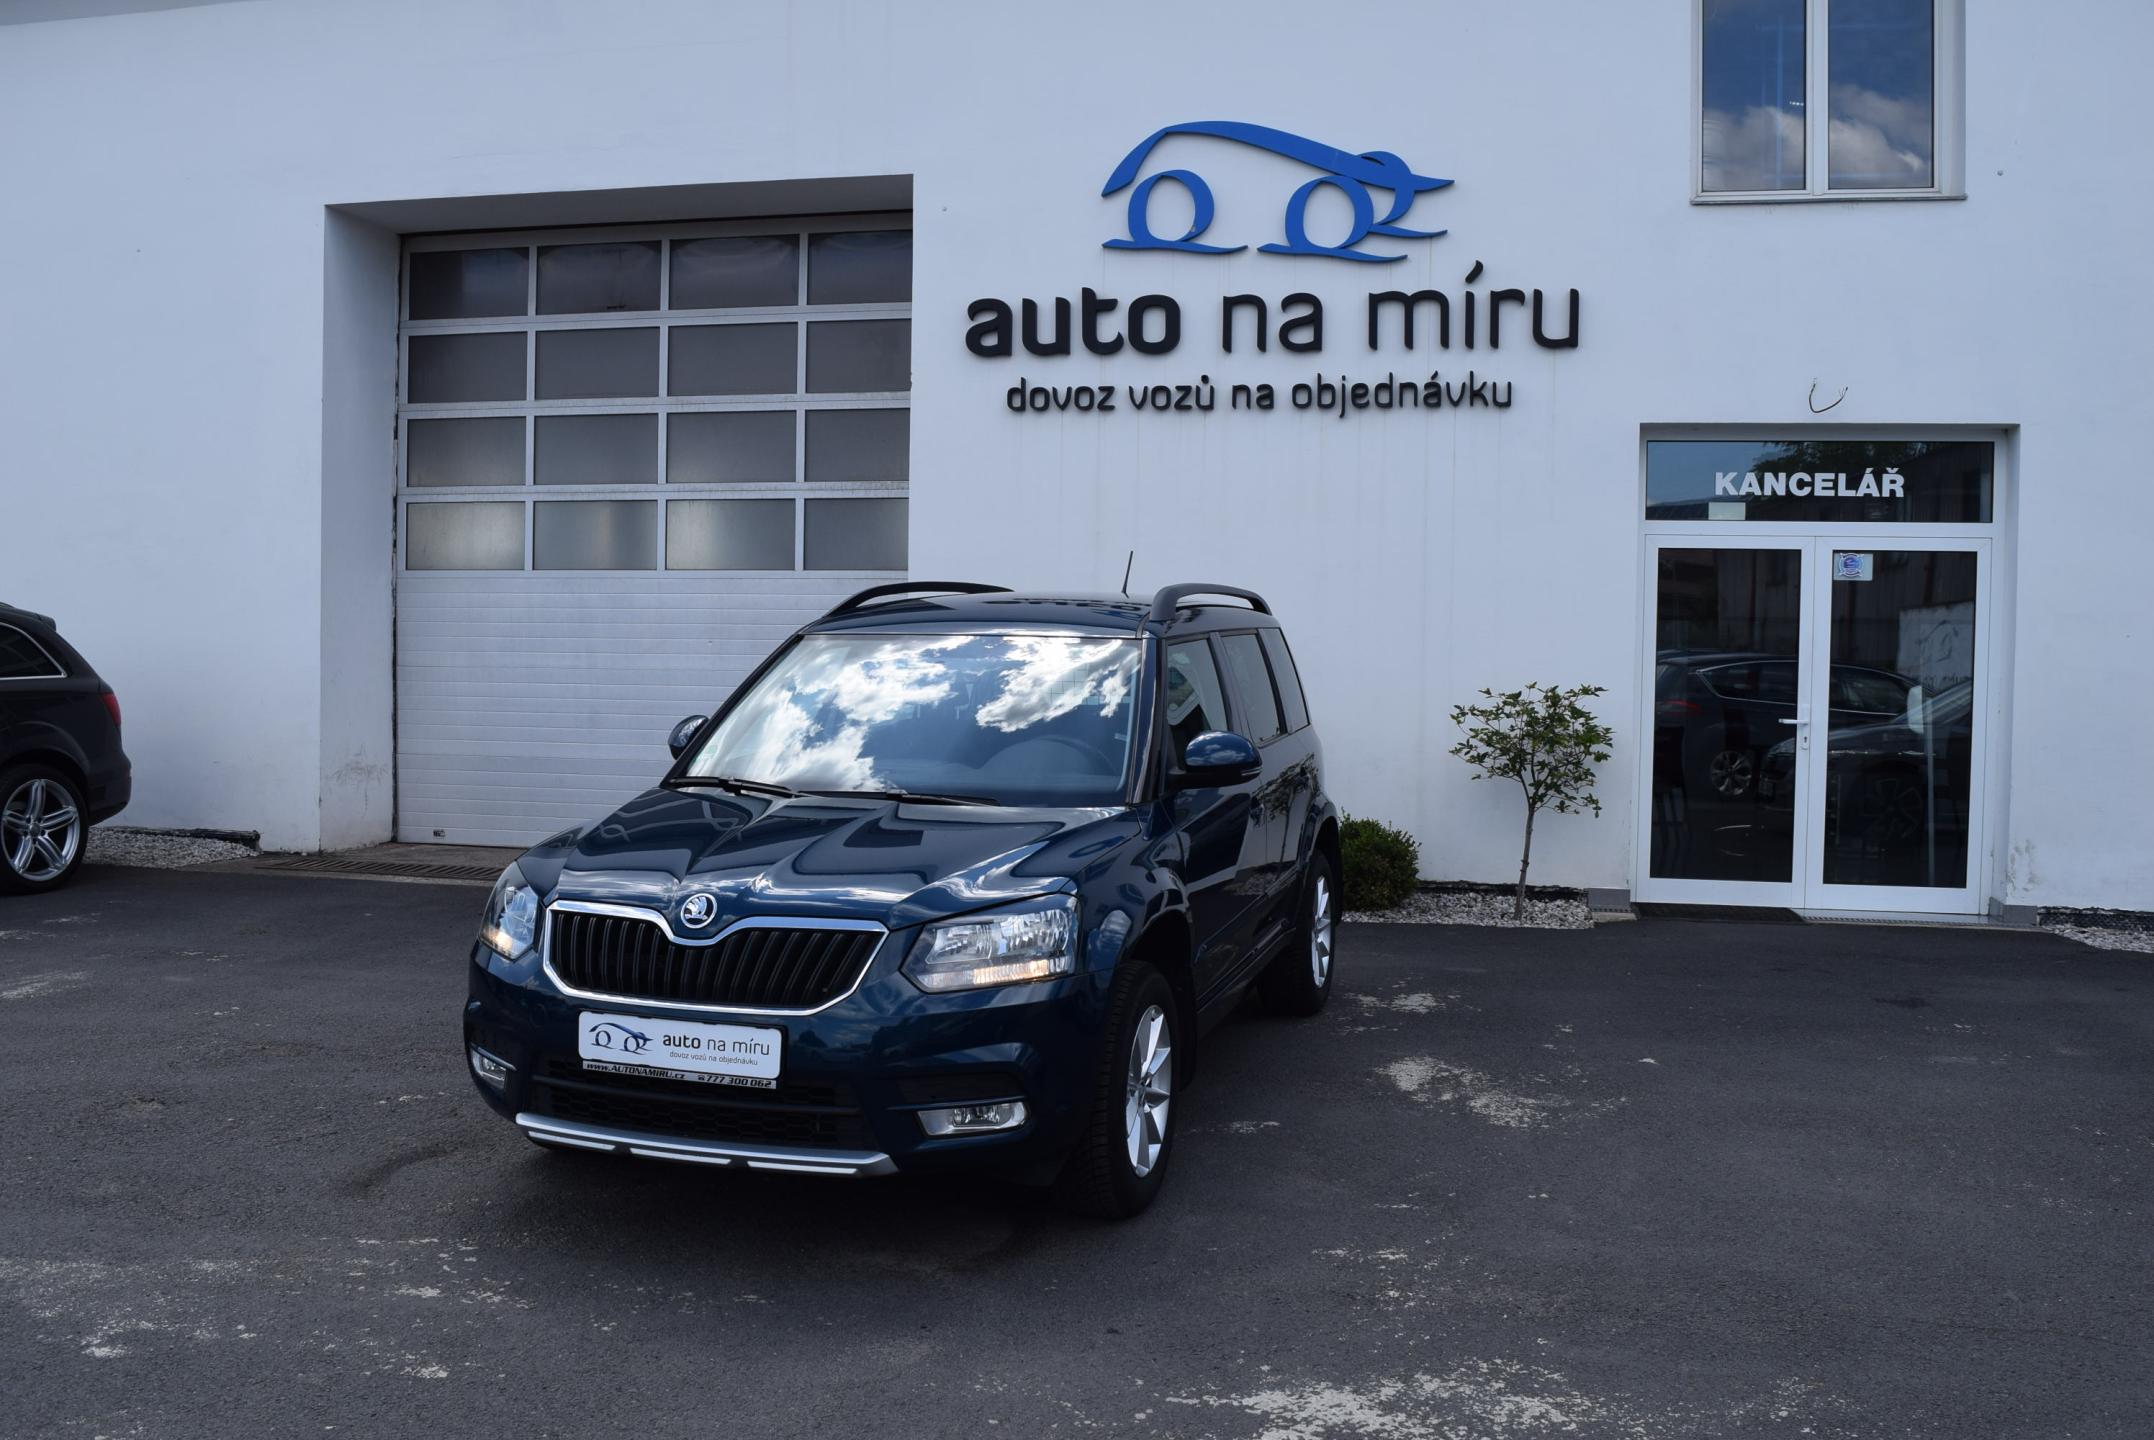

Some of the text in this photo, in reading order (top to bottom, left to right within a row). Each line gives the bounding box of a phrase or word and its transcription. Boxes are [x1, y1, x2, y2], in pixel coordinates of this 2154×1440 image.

[965, 260, 1579, 357] auto na míru
[1006, 370, 1513, 419] dovoz vozů na objednávku
[1714, 467, 1905, 498] KANCELÁŘ
[662, 1034, 770, 1056] auto na míru
[669, 1050, 690, 1059] dovoz
[708, 1055, 717, 1063] na
[718, 1055, 758, 1066] objednávku
[727, 1076, 748, 1086] 300
[749, 1078, 772, 1089] 062
